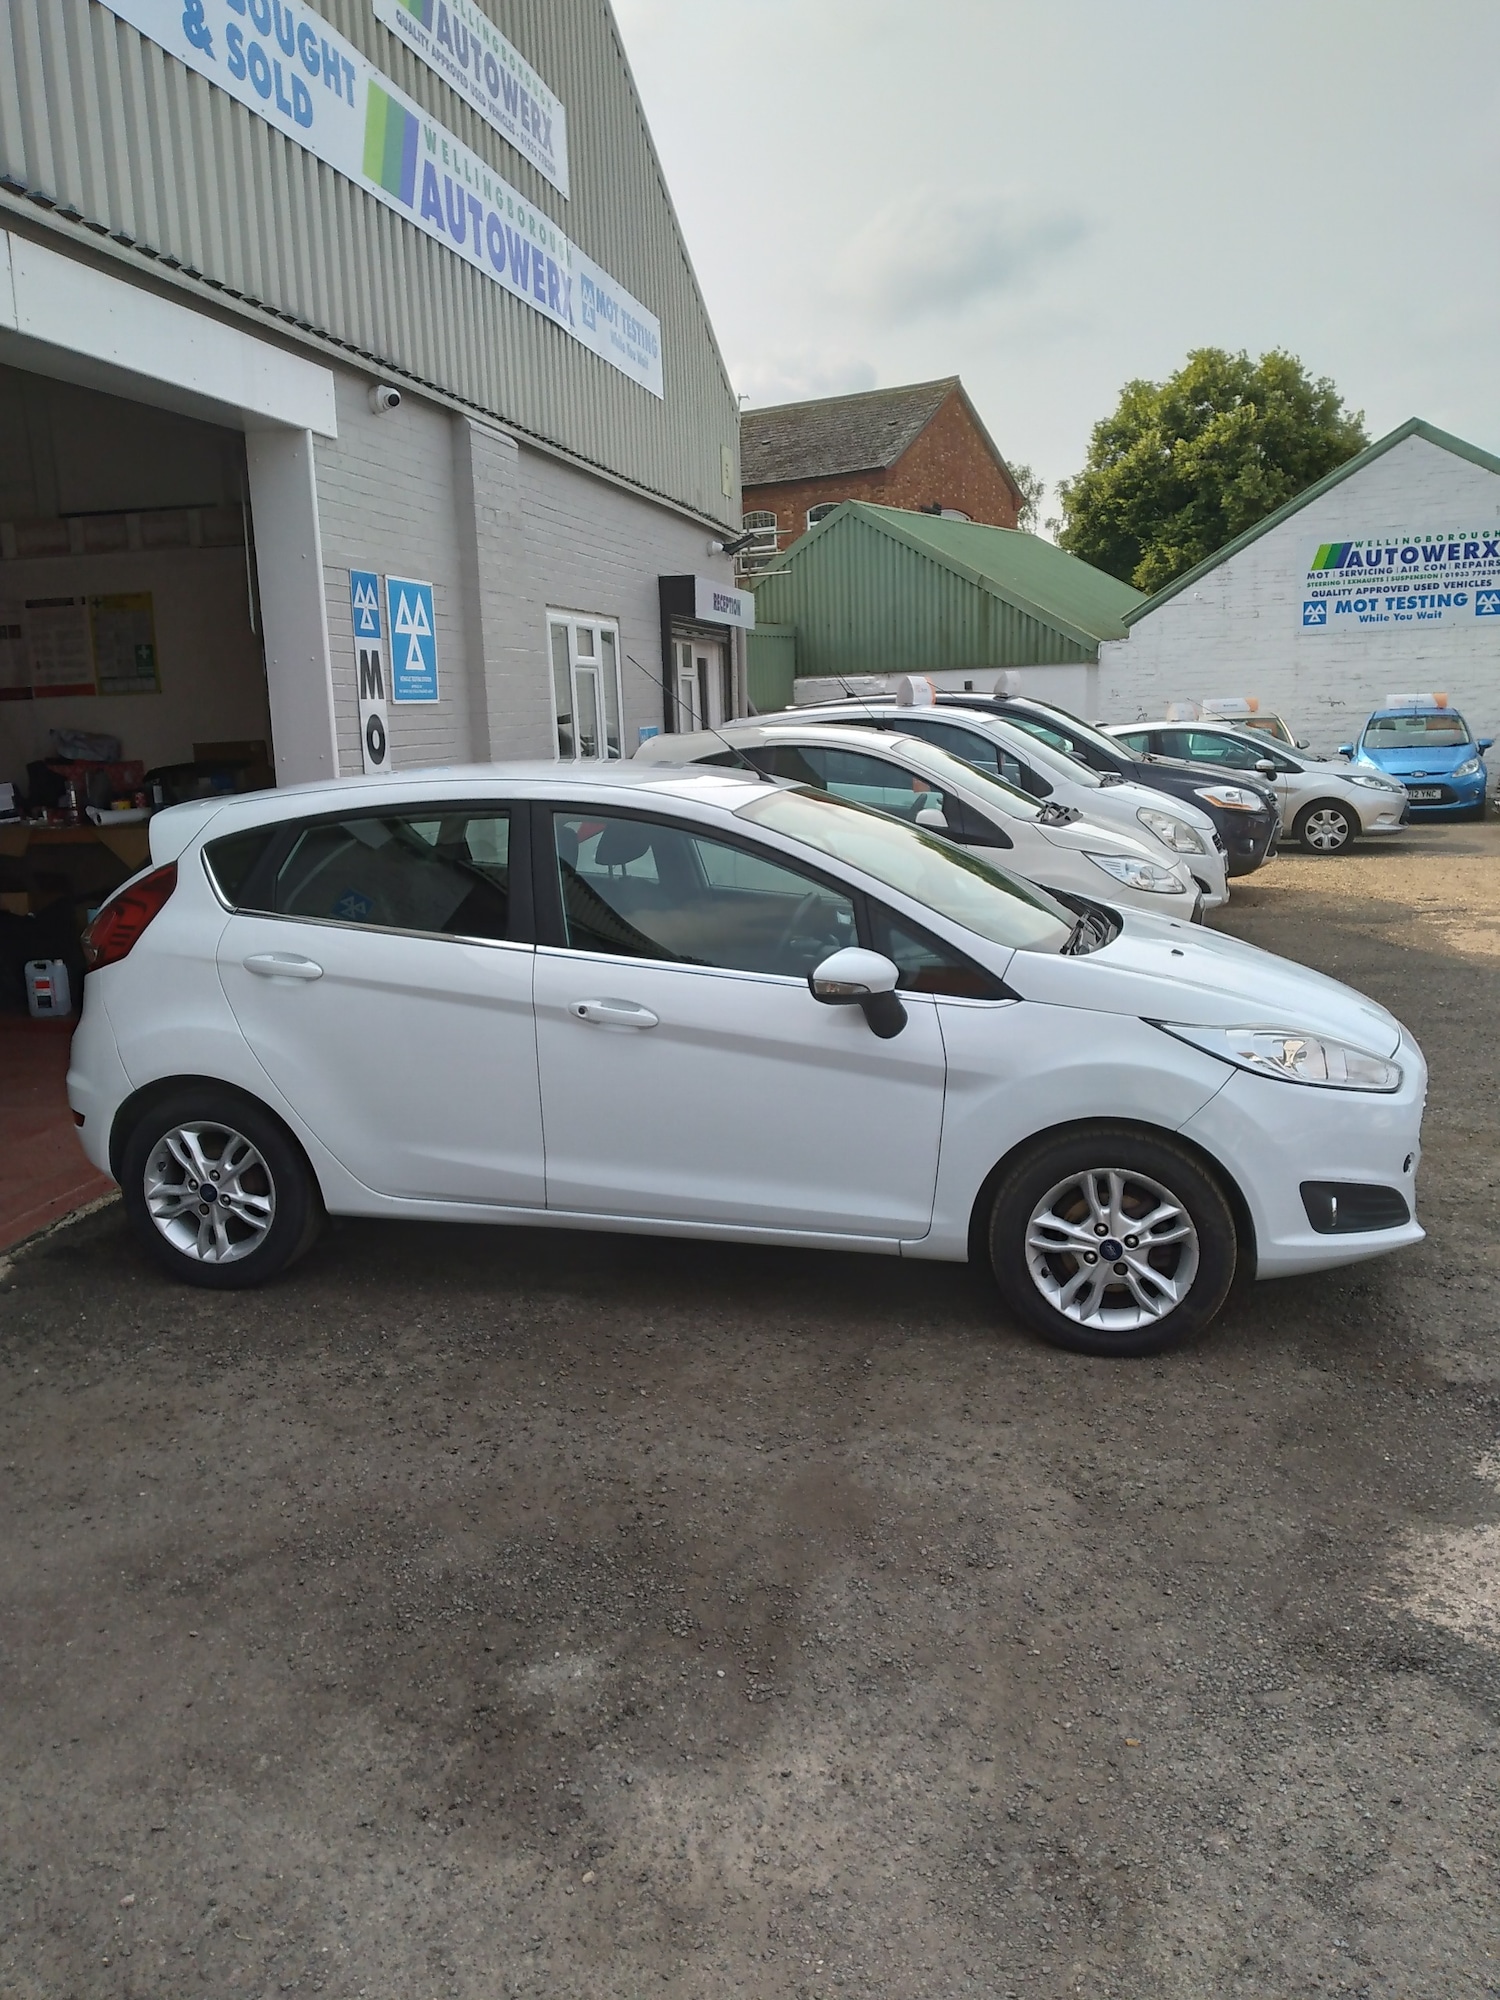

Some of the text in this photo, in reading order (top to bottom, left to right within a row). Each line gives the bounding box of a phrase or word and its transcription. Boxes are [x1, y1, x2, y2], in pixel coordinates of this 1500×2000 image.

[396, 9, 429, 52] QUALITY
[182, 0, 313, 128] & SOLD
[226, 0, 356, 108] OUGHT
[436, 0, 555, 158] AUTOWERX
[424, 124, 572, 269] WELLINGBOROUGH
[421, 159, 575, 327] AUTOWERX
[595, 287, 658, 359] MOT TESTING
[1355, 530, 1500, 548] WELLINGBOROUGH
[1346, 540, 1500, 568] AUTOWERX
[1307, 559, 1500, 580] MOT SERVICING AIR CON REPAIRS
[1307, 580, 1341, 588] STEERING
[1347, 577, 1384, 585] EXHAUSTS
[1391, 573, 1438, 581] SUSPENSION
[1311, 579, 1492, 598] QUALITY APPROVED USED VEHICLES
[713, 592, 741, 616] RECEPTION
[1335, 592, 1468, 614] MOT TESTING
[1359, 610, 1442, 623] While You Wait
